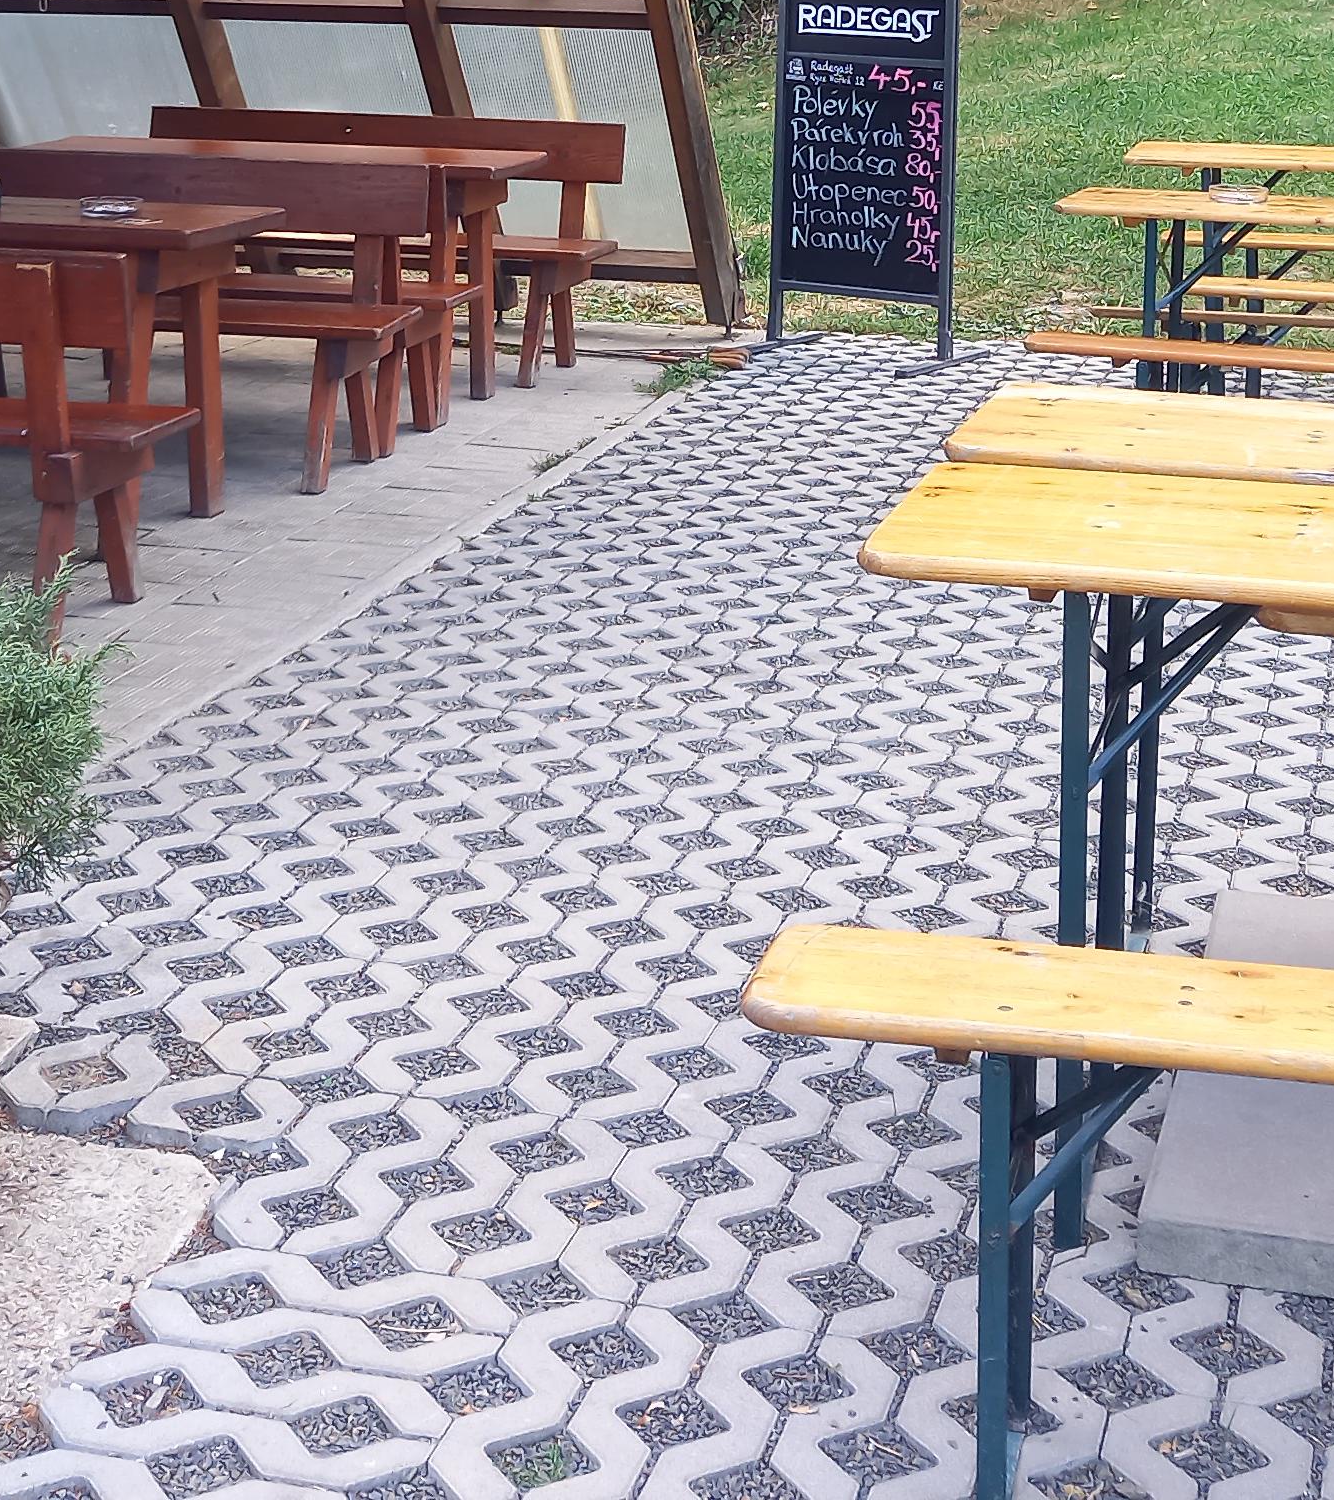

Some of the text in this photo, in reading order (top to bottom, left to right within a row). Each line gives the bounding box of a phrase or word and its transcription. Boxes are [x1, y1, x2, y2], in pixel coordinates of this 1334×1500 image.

[798, 3, 940, 43] RADEGAST
[793, 85, 879, 130] Polévky
[791, 117, 857, 145] Párek
[873, 122, 905, 148] roh
[791, 144, 897, 177] Klobása
[792, 173, 908, 211] Utopenec
[792, 201, 901, 240] Hranolky
[791, 223, 890, 267] Nanuky
